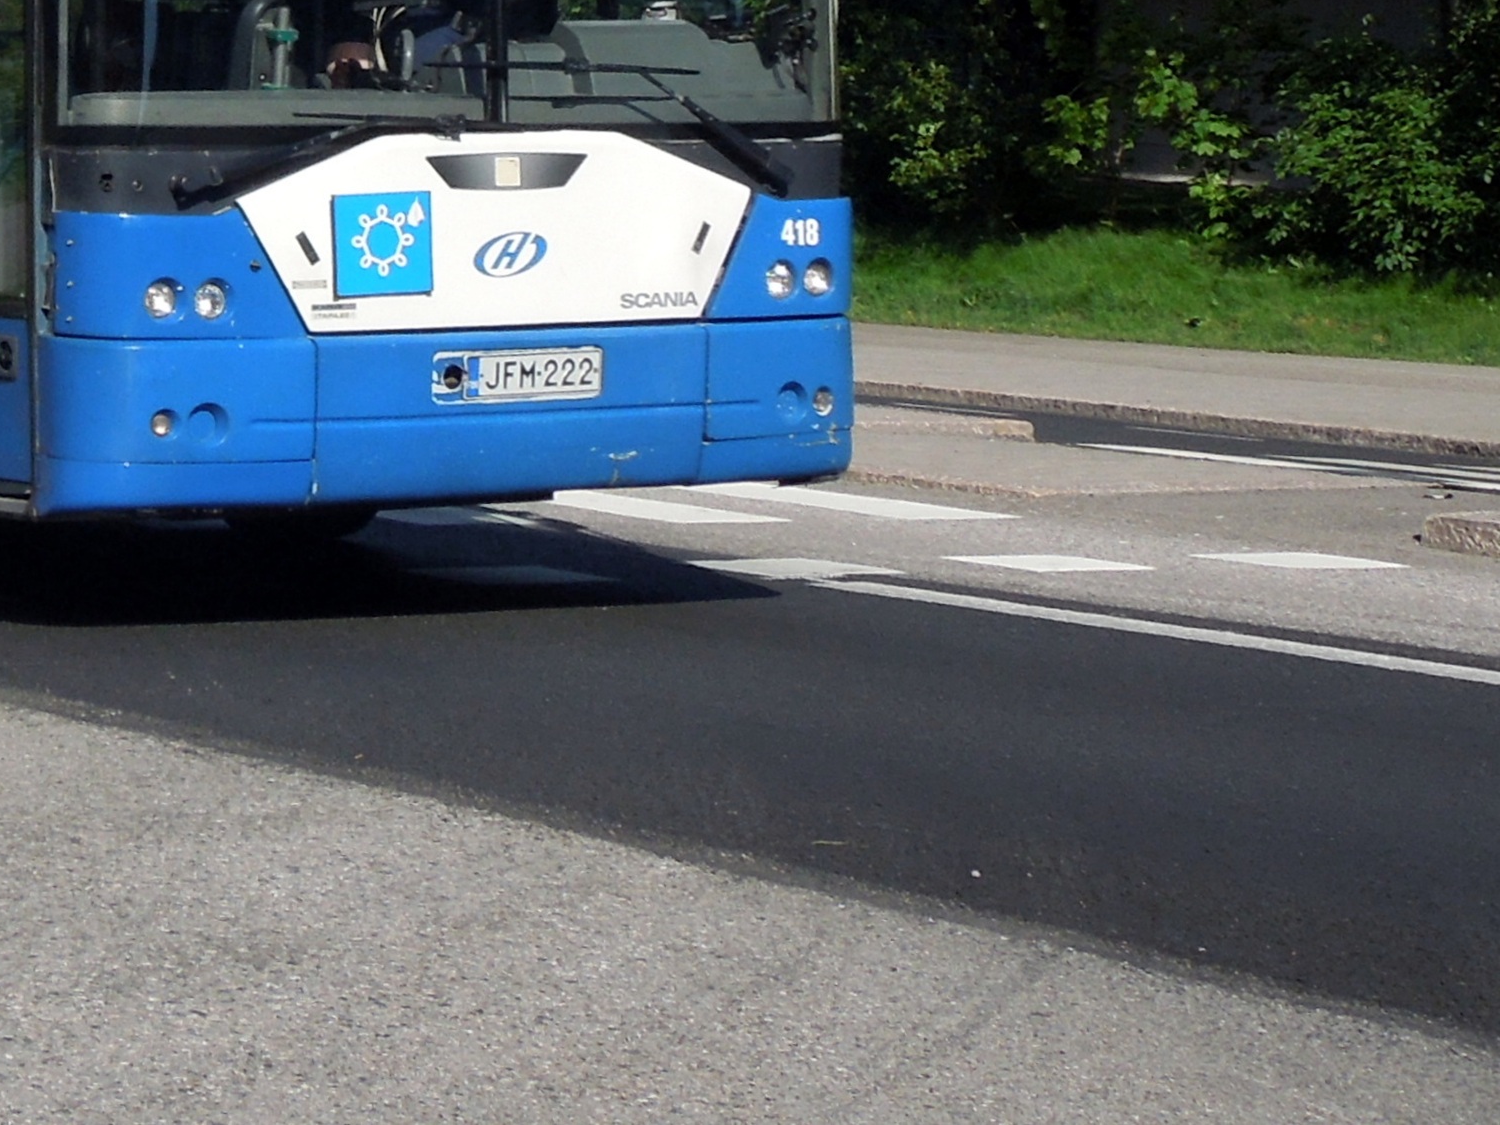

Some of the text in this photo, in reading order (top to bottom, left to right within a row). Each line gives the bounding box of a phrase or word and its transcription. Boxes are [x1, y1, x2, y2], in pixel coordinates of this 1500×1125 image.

[780, 218, 819, 246] 418
[620, 291, 698, 309] SCANIA
[485, 357, 593, 390] JFM-222
